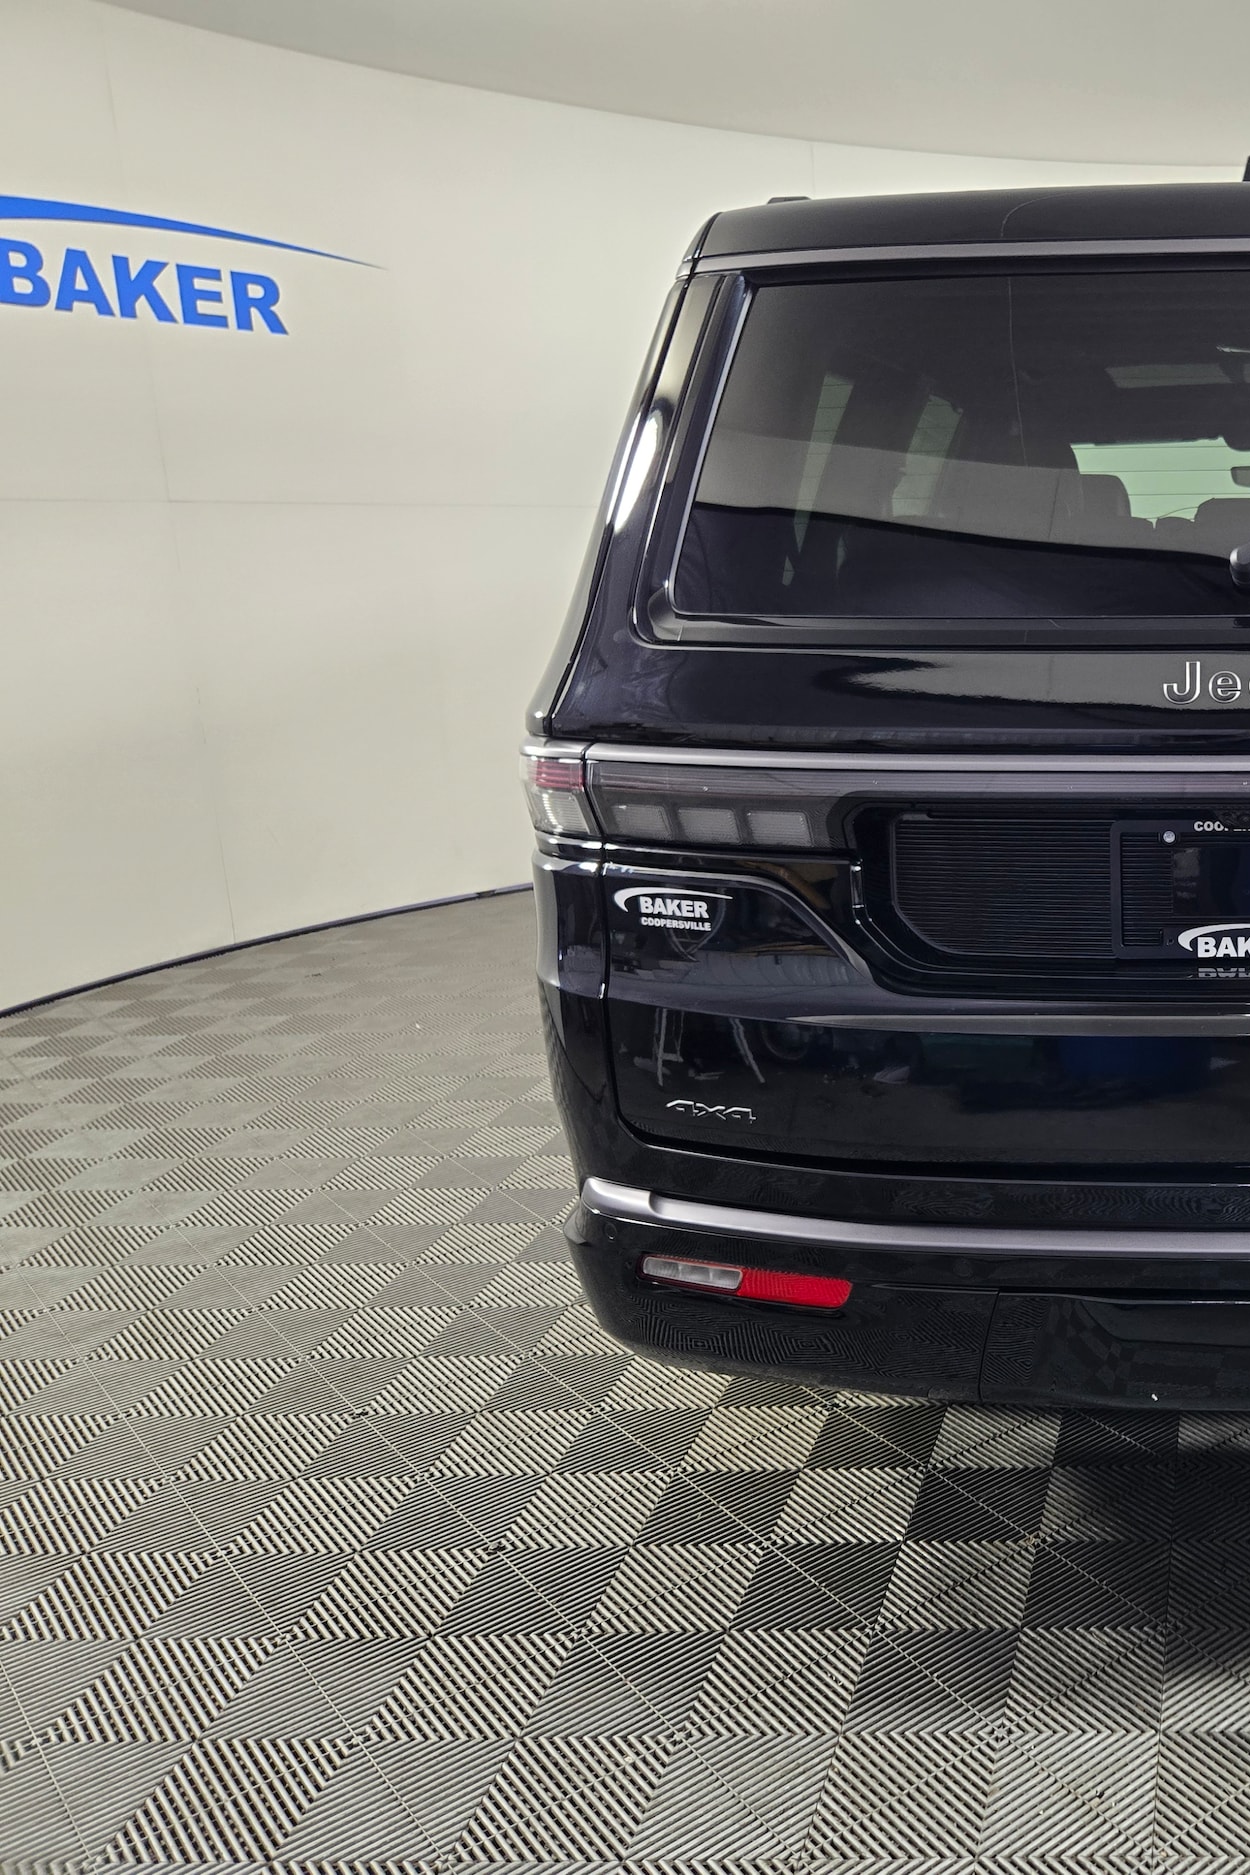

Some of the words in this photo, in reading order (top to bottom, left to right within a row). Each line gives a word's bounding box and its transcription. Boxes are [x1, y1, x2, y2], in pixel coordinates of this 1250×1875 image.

[0, 238, 288, 335] BAKER
[639, 896, 709, 919] BAKER
[641, 916, 712, 931] COOPERSVILLE
